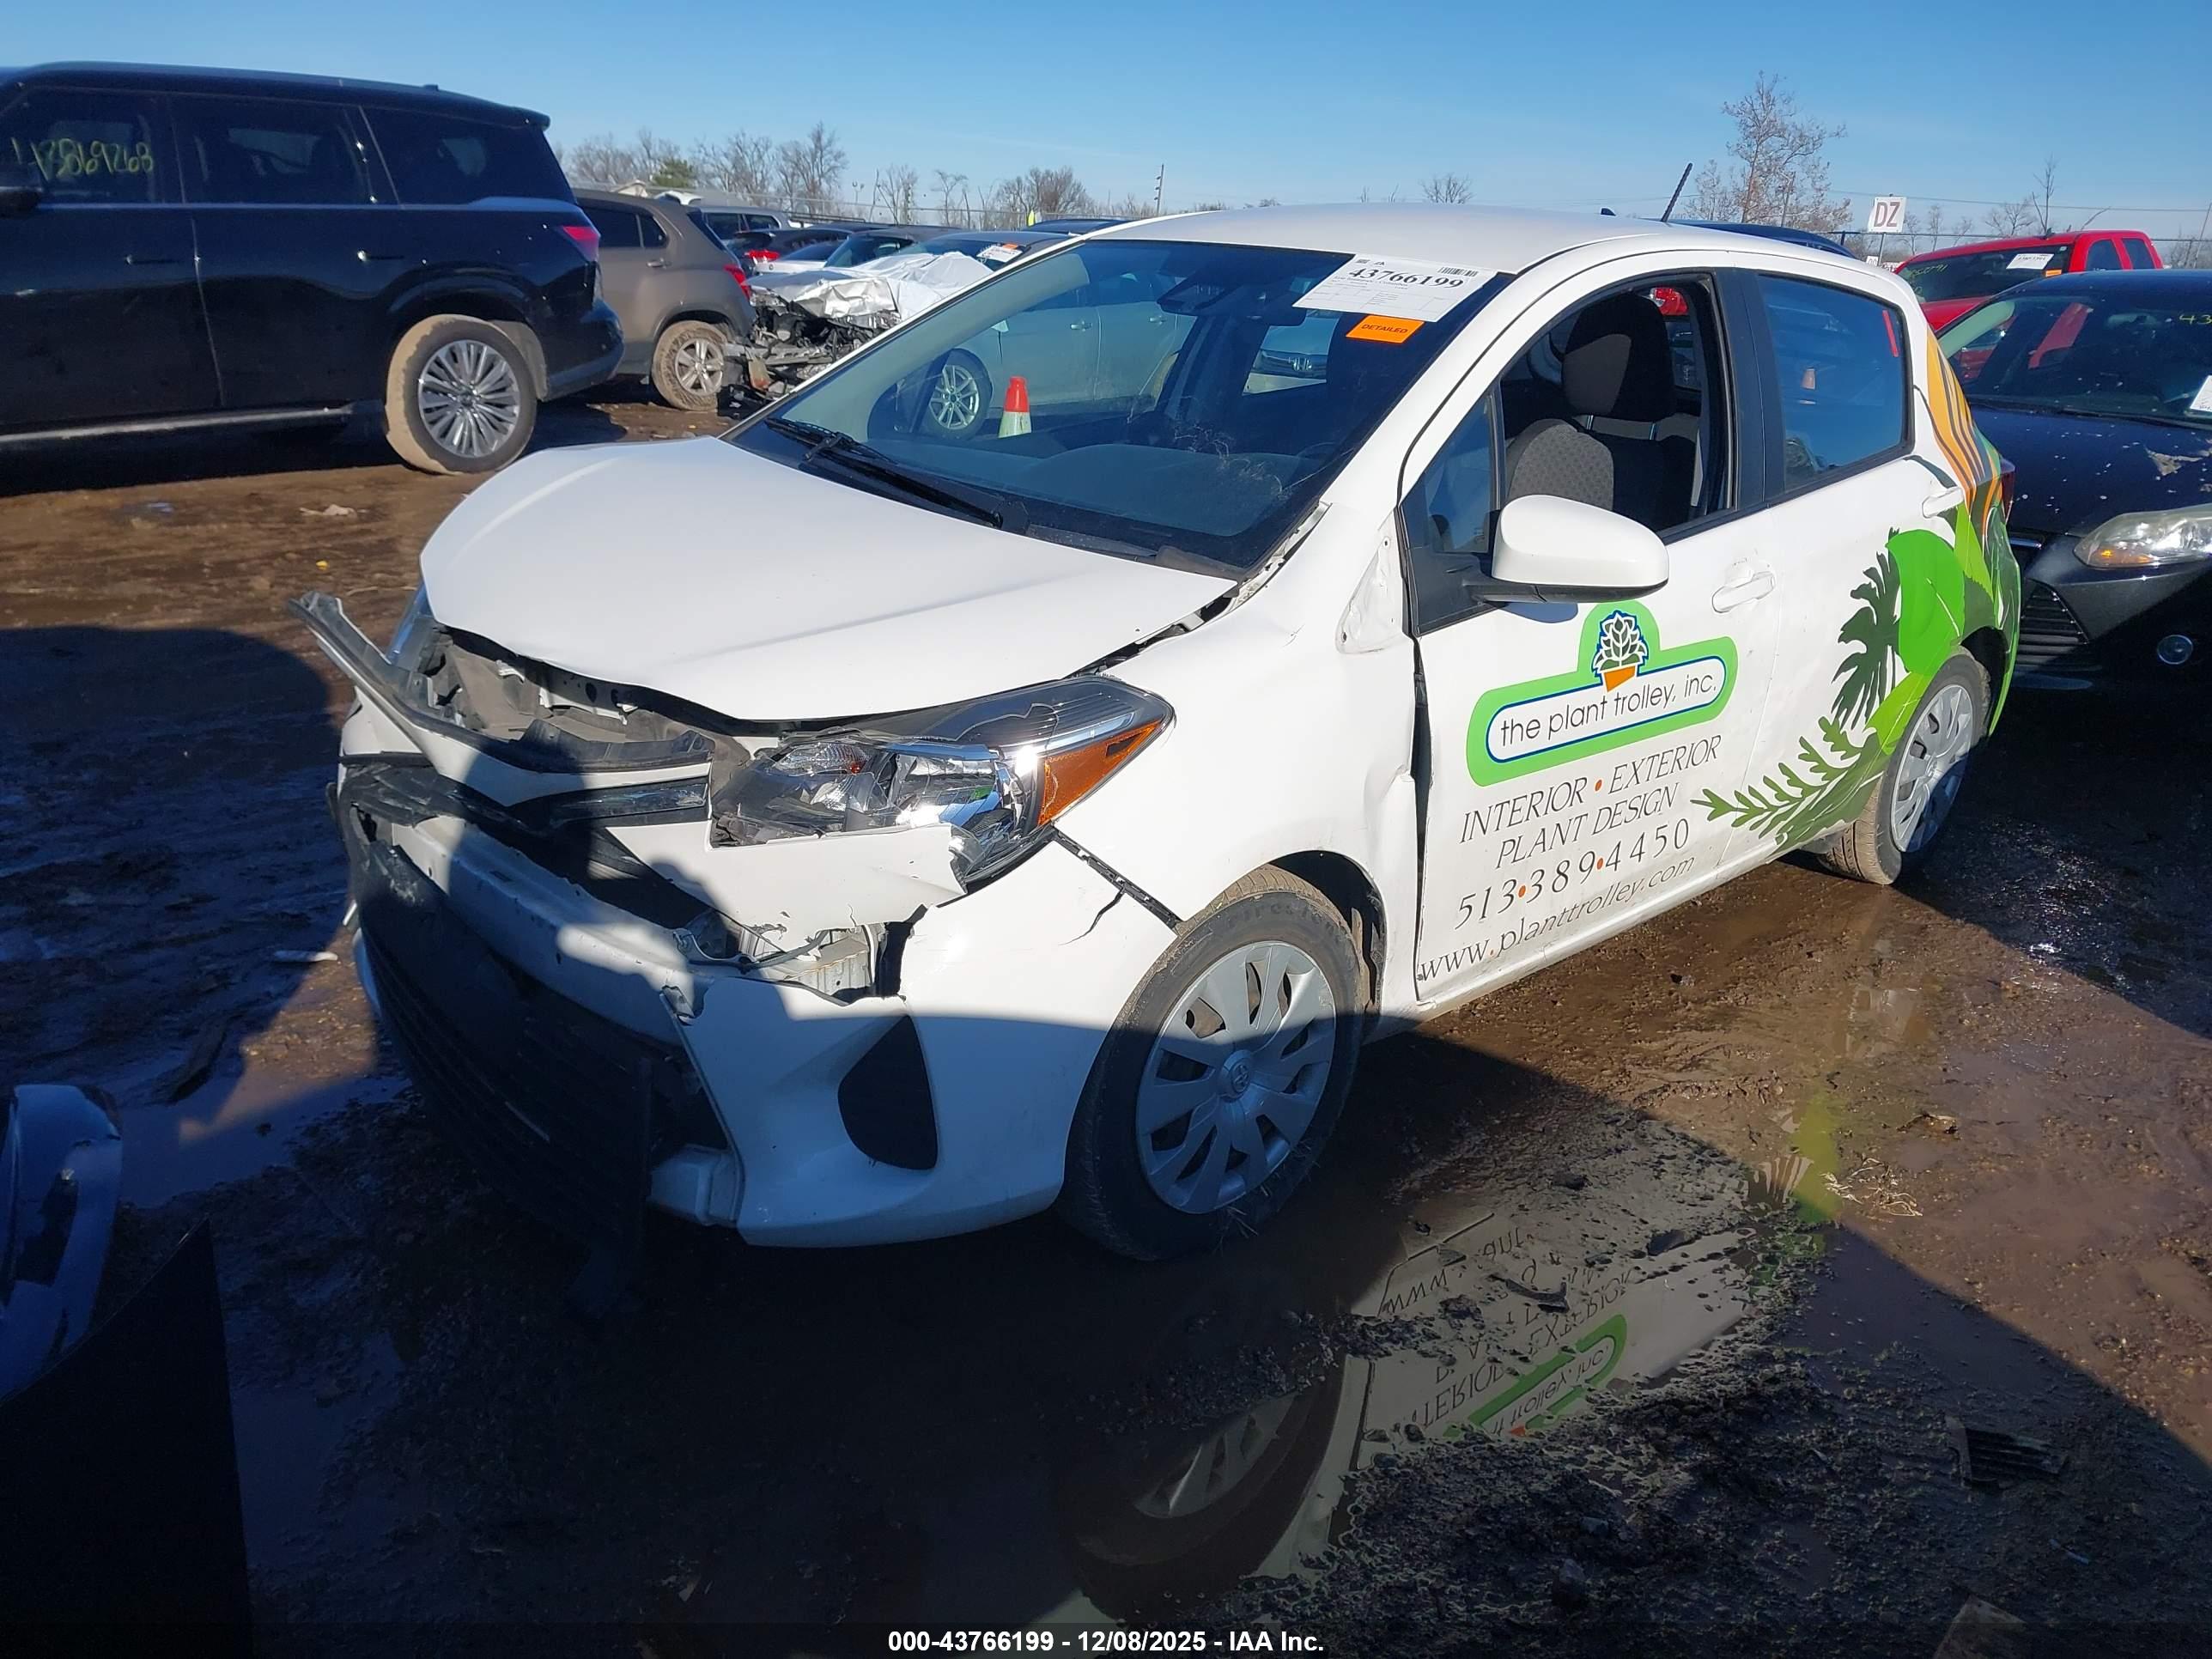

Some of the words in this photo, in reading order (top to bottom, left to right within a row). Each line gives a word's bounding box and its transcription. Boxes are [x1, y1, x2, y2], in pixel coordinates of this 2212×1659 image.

[1349, 268, 1464, 289] 43766199
[1361, 324, 1408, 334] DETAILED
[1501, 718, 1540, 746] the
[1548, 696, 1607, 740] plant
[1613, 684, 1676, 715] trolley,
[1684, 674, 1717, 698] inc.
[1460, 777, 1587, 843] INTERIOR
[1607, 735, 1721, 794] EXTERIOR
[1496, 813, 1588, 869] PLANT
[1592, 783, 1679, 836] DESIGN
[1421, 855, 1695, 981] www.planttrolley.com
